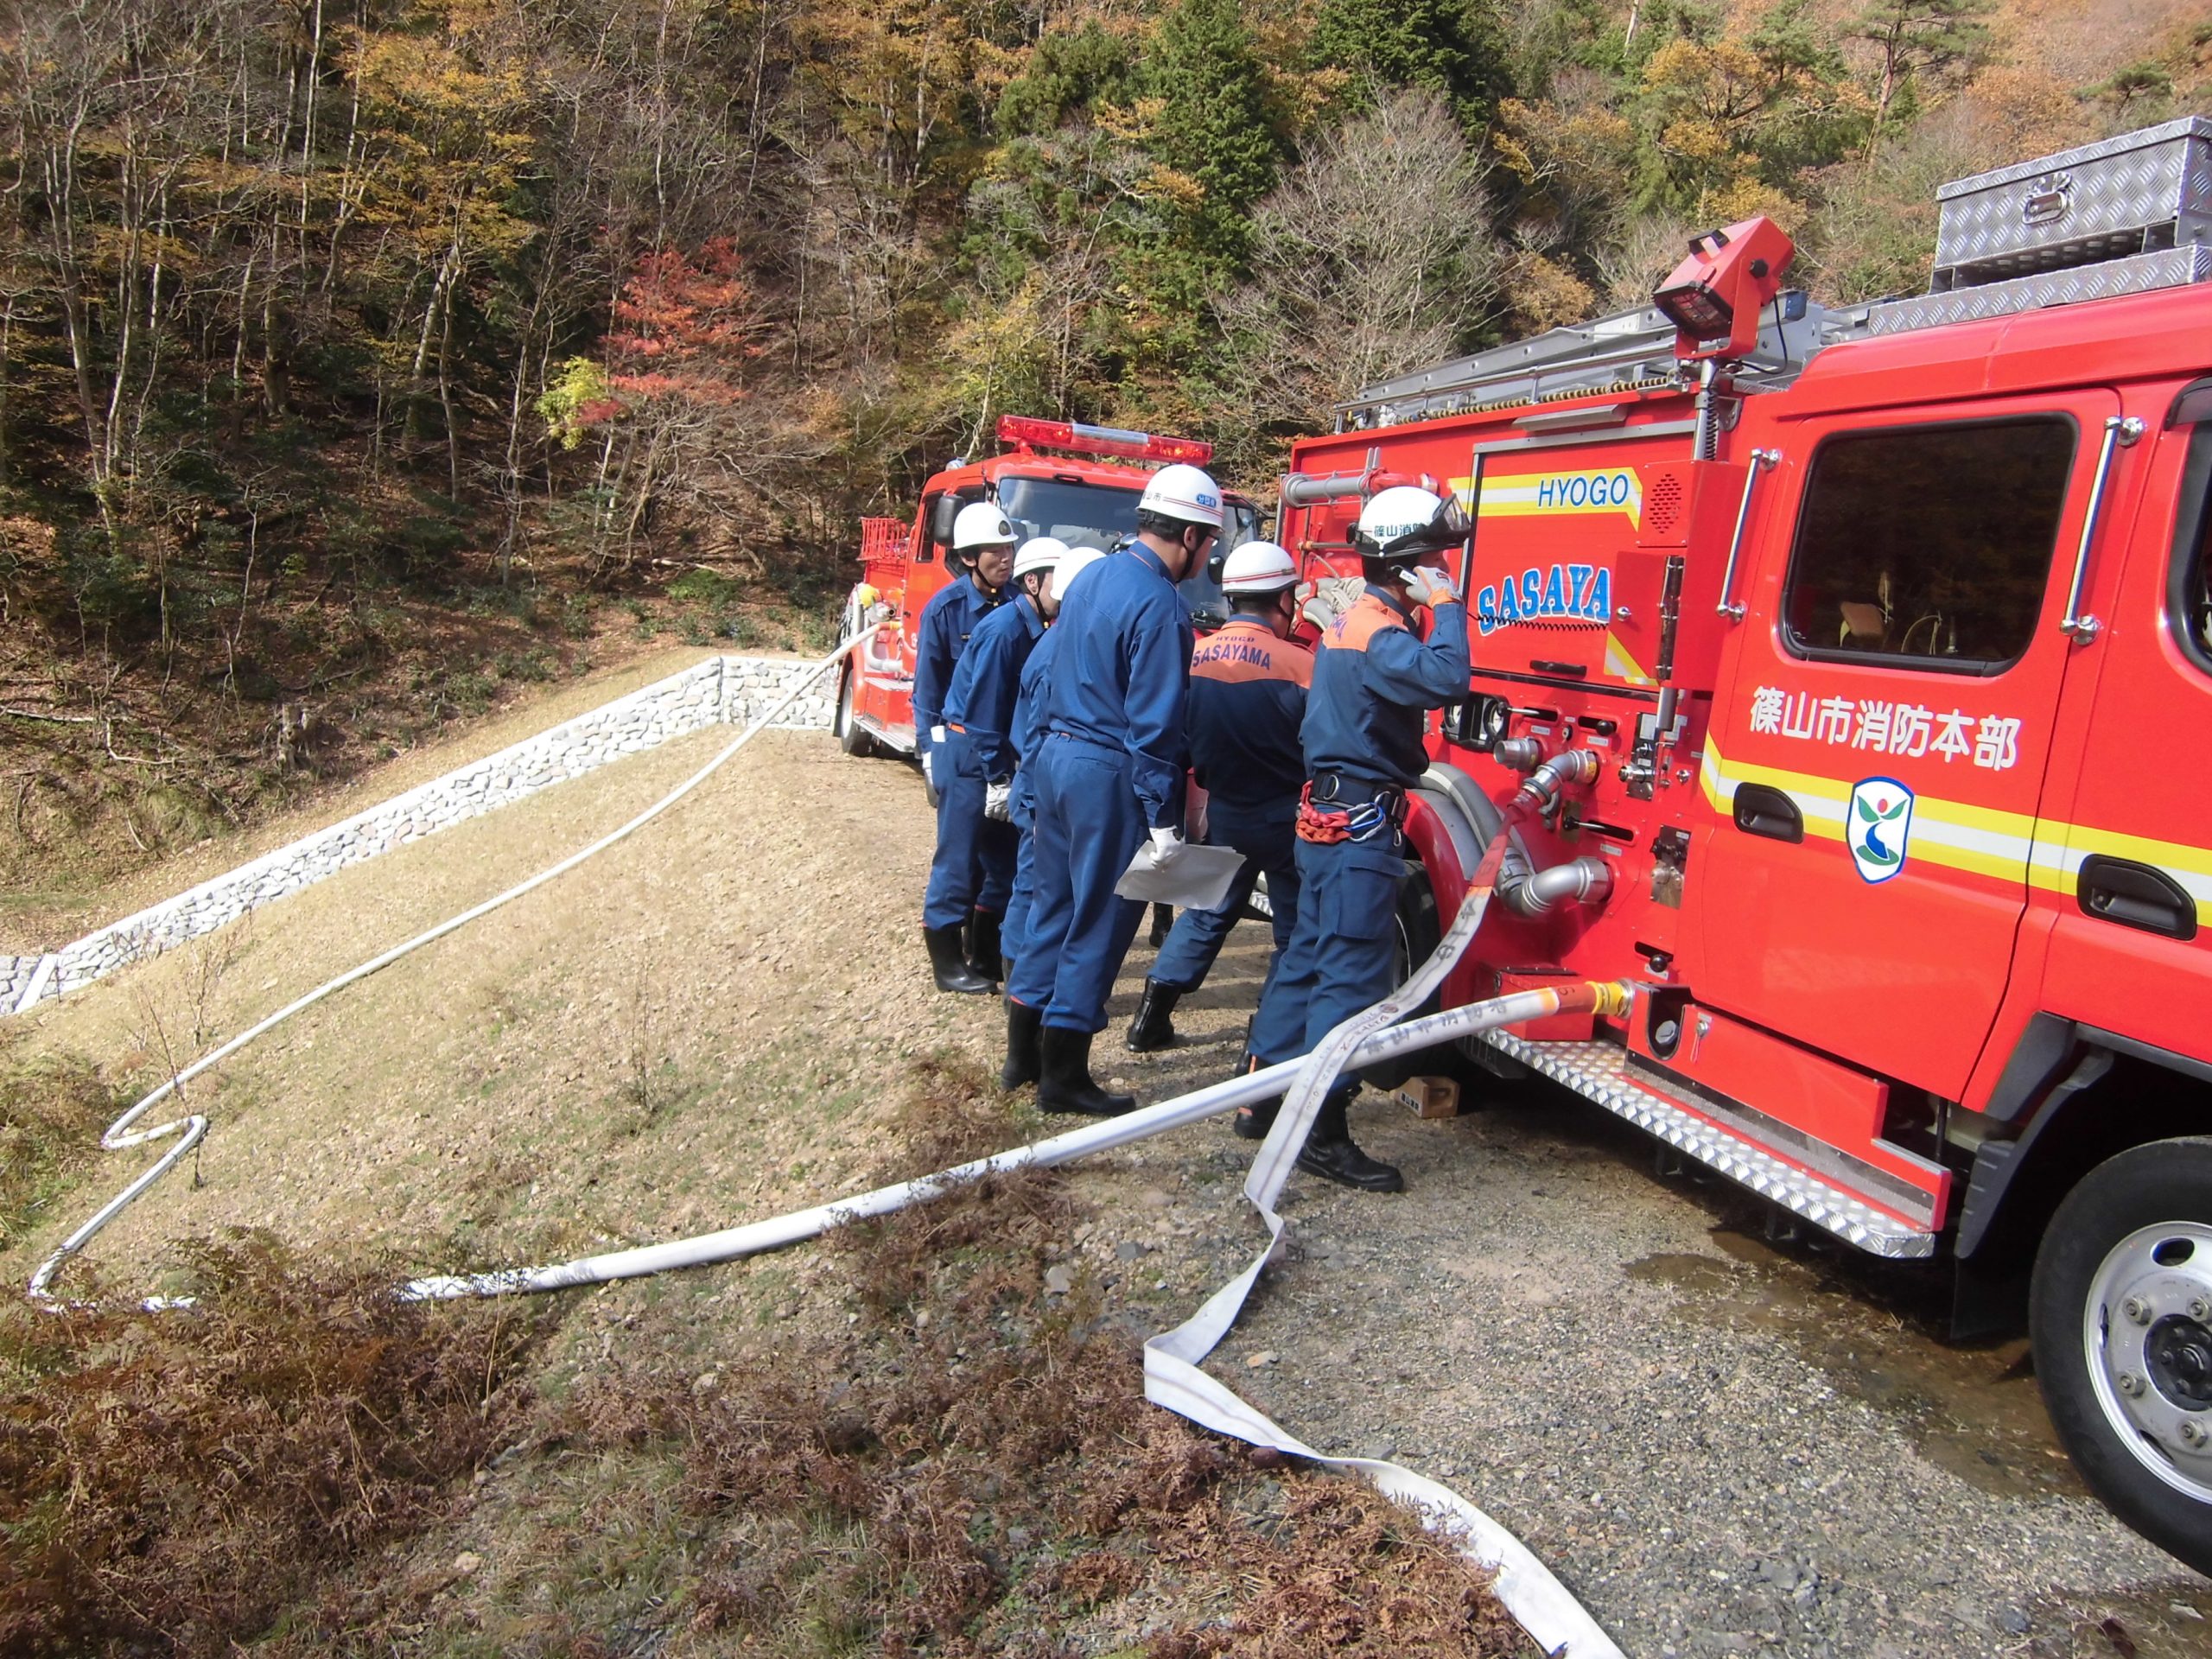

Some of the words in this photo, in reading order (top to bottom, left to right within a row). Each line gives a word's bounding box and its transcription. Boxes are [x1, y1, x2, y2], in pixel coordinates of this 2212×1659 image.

[1538, 474, 1629, 507] HYOGO
[1478, 564, 1611, 635] SASAYA
[1192, 644, 1271, 671] SASAYAMA
[1750, 685, 2021, 771] 篠山市消防本部
